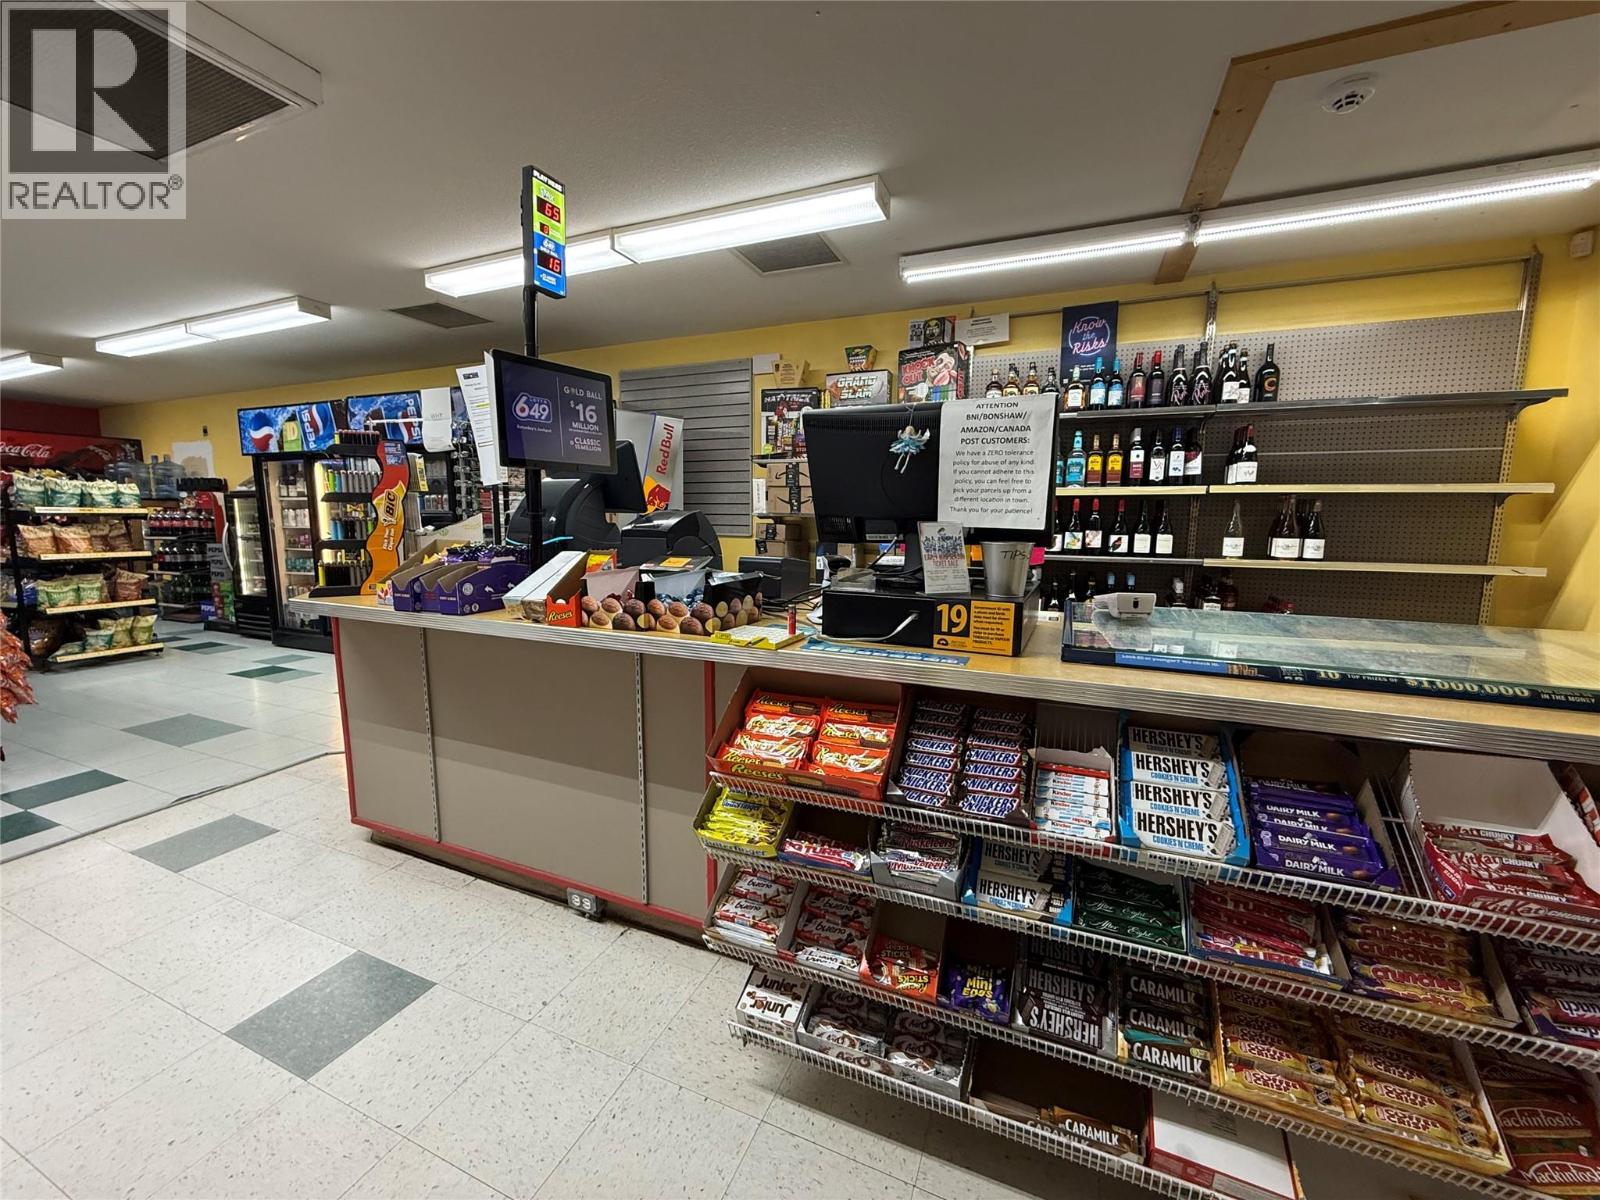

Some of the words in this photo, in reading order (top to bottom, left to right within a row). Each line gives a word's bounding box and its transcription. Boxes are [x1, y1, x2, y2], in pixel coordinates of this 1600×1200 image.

[545, 202, 560, 221] 65
[549, 258, 560, 273] 16
[1072, 318, 1107, 333] Know
[1081, 329, 1096, 342] the
[1072, 338, 1107, 354] Risks
[901, 355, 936, 374] KNOCK
[836, 375, 878, 387] GRAND
[902, 371, 924, 386] OUT
[586, 390, 602, 400] BALL
[840, 387, 873, 400] SLAM
[515, 396, 549, 420] 649
[966, 411, 1028, 421] BNI/BONSHAW/
[302, 409, 317, 450] PEPSI
[572, 421, 599, 432] MILLION
[960, 425, 1031, 434] AMAZON/CANADA
[574, 437, 601, 446] CLASSIC
[661, 423, 675, 449] Bull
[981, 437, 1030, 445] CUSTOMERS:
[656, 449, 670, 475] Red
[953, 459, 970, 467] policy
[386, 491, 396, 516] BIC
[1005, 507, 1033, 515] patience!
[936, 603, 968, 634] 19
[1406, 678, 1530, 698] $1,000,000
[1132, 727, 1204, 751] HERSHEY'S
[906, 752, 953, 770] SNICKERS
[967, 749, 1018, 765] SNICKERS
[731, 764, 785, 781] Reese's
[965, 763, 1020, 779] SNICKERS
[1136, 752, 1210, 779] HERSHEY'S
[963, 778, 1014, 794] SNICKERS
[1150, 772, 1173, 782] COOKIES
[1179, 775, 1199, 785] CREME
[1053, 789, 1072, 797] Kinder
[1135, 783, 1212, 809] HERSHEY'S
[1150, 802, 1173, 813] COOKIES
[1180, 805, 1201, 816] CREME
[1266, 805, 1295, 815] DAIRY
[1296, 808, 1321, 818] MILK
[1051, 821, 1071, 829] Kinder
[1137, 810, 1218, 844] HERSHEY'S
[1152, 835, 1177, 847] COOKIES
[1184, 839, 1205, 851] CREME
[1278, 835, 1309, 847] DAIRY
[1310, 839, 1337, 851] MILK
[1480, 830, 1516, 841] CHUNKY
[985, 842, 1041, 865] HERSHEY'S
[1285, 859, 1317, 872] DAIRY
[1318, 865, 1345, 877] MILK
[1502, 856, 1540, 870] CHUNKY
[747, 878, 773, 889] bueno
[980, 879, 1037, 905] HERSHEY'S
[735, 900, 761, 911] bueno
[823, 897, 854, 913] bueno
[1089, 899, 1116, 912] After
[816, 921, 846, 936] bueno
[1093, 919, 1119, 932] After
[1127, 926, 1157, 941] Eight
[882, 950, 911, 958] STICKS
[755, 974, 798, 992] Junior
[966, 977, 993, 991] Mini
[1028, 968, 1096, 1003] HERSHEY'S
[1371, 965, 1464, 992] Crunchie
[1130, 975, 1196, 1006] CARAMILK
[749, 999, 793, 1018] Junior
[1029, 1006, 1100, 1048] HERSHEY'S
[1129, 1008, 1197, 1039] CARAMILK
[1133, 1042, 1203, 1074] CARAMILK
[1247, 1048, 1285, 1062] CRISP
[1253, 1079, 1291, 1093] CRISP
[1384, 1108, 1440, 1128] COFFEE
[1385, 1114, 1430, 1131] CRISP
[1065, 1118, 1119, 1146] CARAMILK
